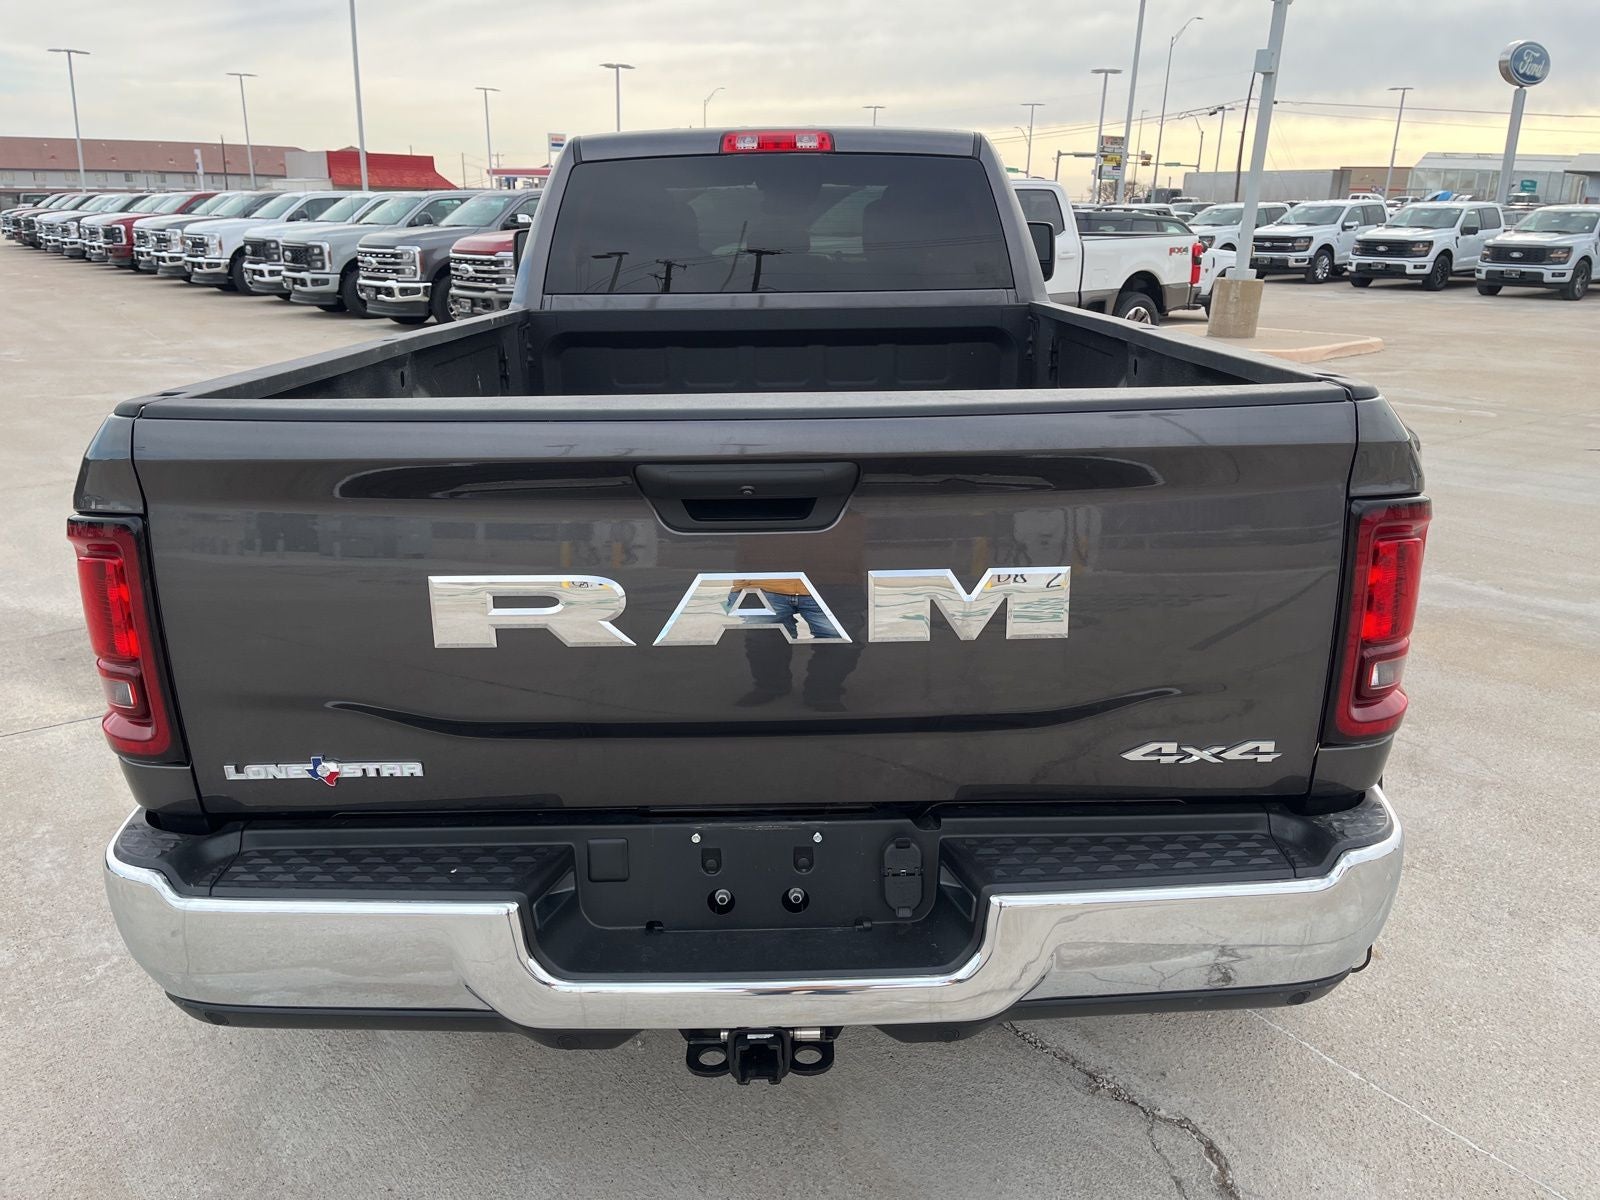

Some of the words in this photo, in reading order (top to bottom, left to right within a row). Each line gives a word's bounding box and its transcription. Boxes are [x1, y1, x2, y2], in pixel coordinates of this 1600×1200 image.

[428, 566, 1072, 648] RAM
[223, 763, 311, 780] LONE
[339, 761, 424, 778] STAR
